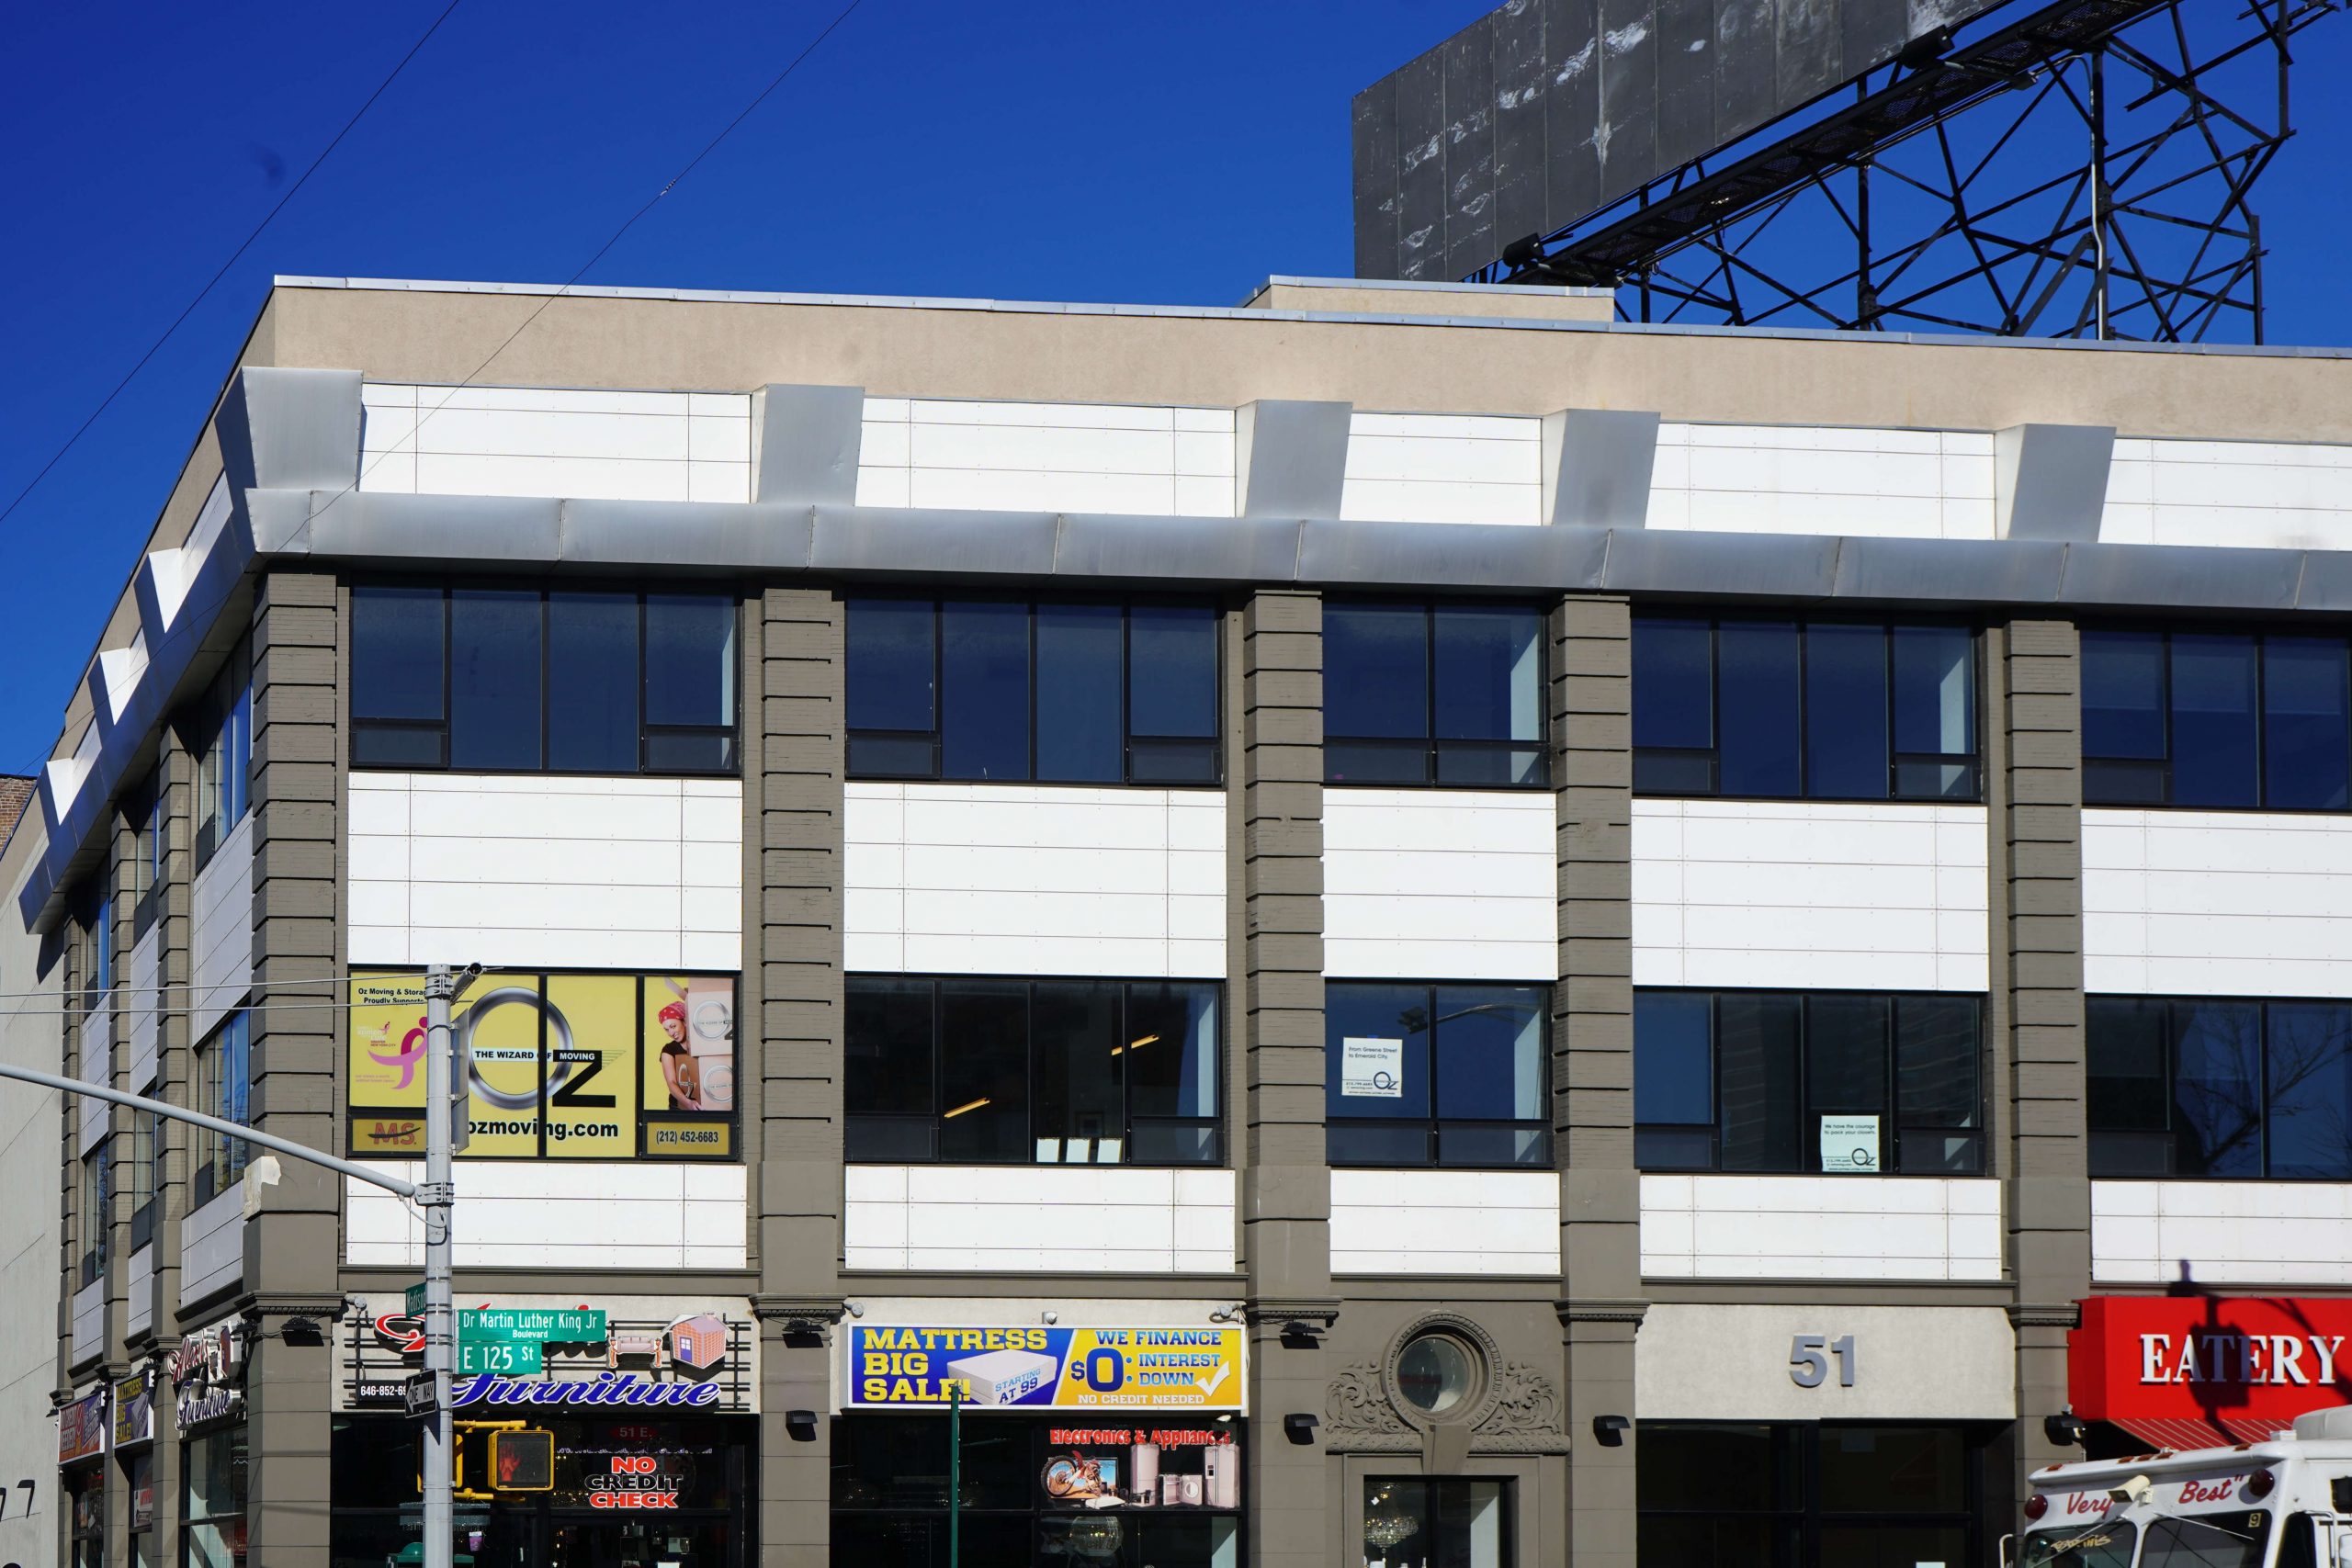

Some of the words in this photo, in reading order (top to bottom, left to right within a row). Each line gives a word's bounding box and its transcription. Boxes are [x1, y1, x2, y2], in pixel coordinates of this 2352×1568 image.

[369, 988, 394, 997] Moving
[497, 1051, 534, 1059] WIZARD
[656, 1130, 678, 1145] (212)
[680, 1130, 718, 1144] 452-6683
[463, 1314, 475, 1328] Dr
[480, 1313, 514, 1328] Martin
[518, 1313, 553, 1328] Luther
[559, 1314, 582, 1333] King
[585, 1314, 597, 1329] Jr
[513, 1330, 548, 1338] Boulevard
[864, 1328, 1048, 1350] MATTRESS
[1095, 1331, 1128, 1346] WE
[1136, 1331, 1222, 1346] FINANCE
[463, 1347, 473, 1370] E
[482, 1347, 513, 1370] 125
[522, 1346, 534, 1361] St
[864, 1352, 929, 1376] BIG
[1139, 1354, 1220, 1367] INTEREST
[1789, 1333, 1855, 1388] 51
[2139, 1333, 2345, 1384] EATERY
[995, 1368, 1041, 1392] STARTING
[1139, 1372, 1194, 1385] DOWN
[424, 1382, 434, 1401] WAY
[864, 1378, 970, 1402] SALE!
[999, 1387, 1016, 1404] AT
[1020, 1377, 1038, 1393] 99
[1079, 1394, 1097, 1404] NO
[1101, 1394, 1148, 1404] CREDIT
[1152, 1394, 1204, 1404] NEEDED
[619, 1427, 635, 1437] 51
[639, 1427, 652, 1437] E.
[1050, 1428, 1131, 1445] Electronics
[1135, 1429, 1146, 1445] &
[612, 1457, 656, 1473] NO
[584, 1474, 684, 1490] CREDIT
[590, 1492, 678, 1508] CHECK
[2066, 1490, 2114, 1519] Very
[2251, 1514, 2259, 1527] 9
